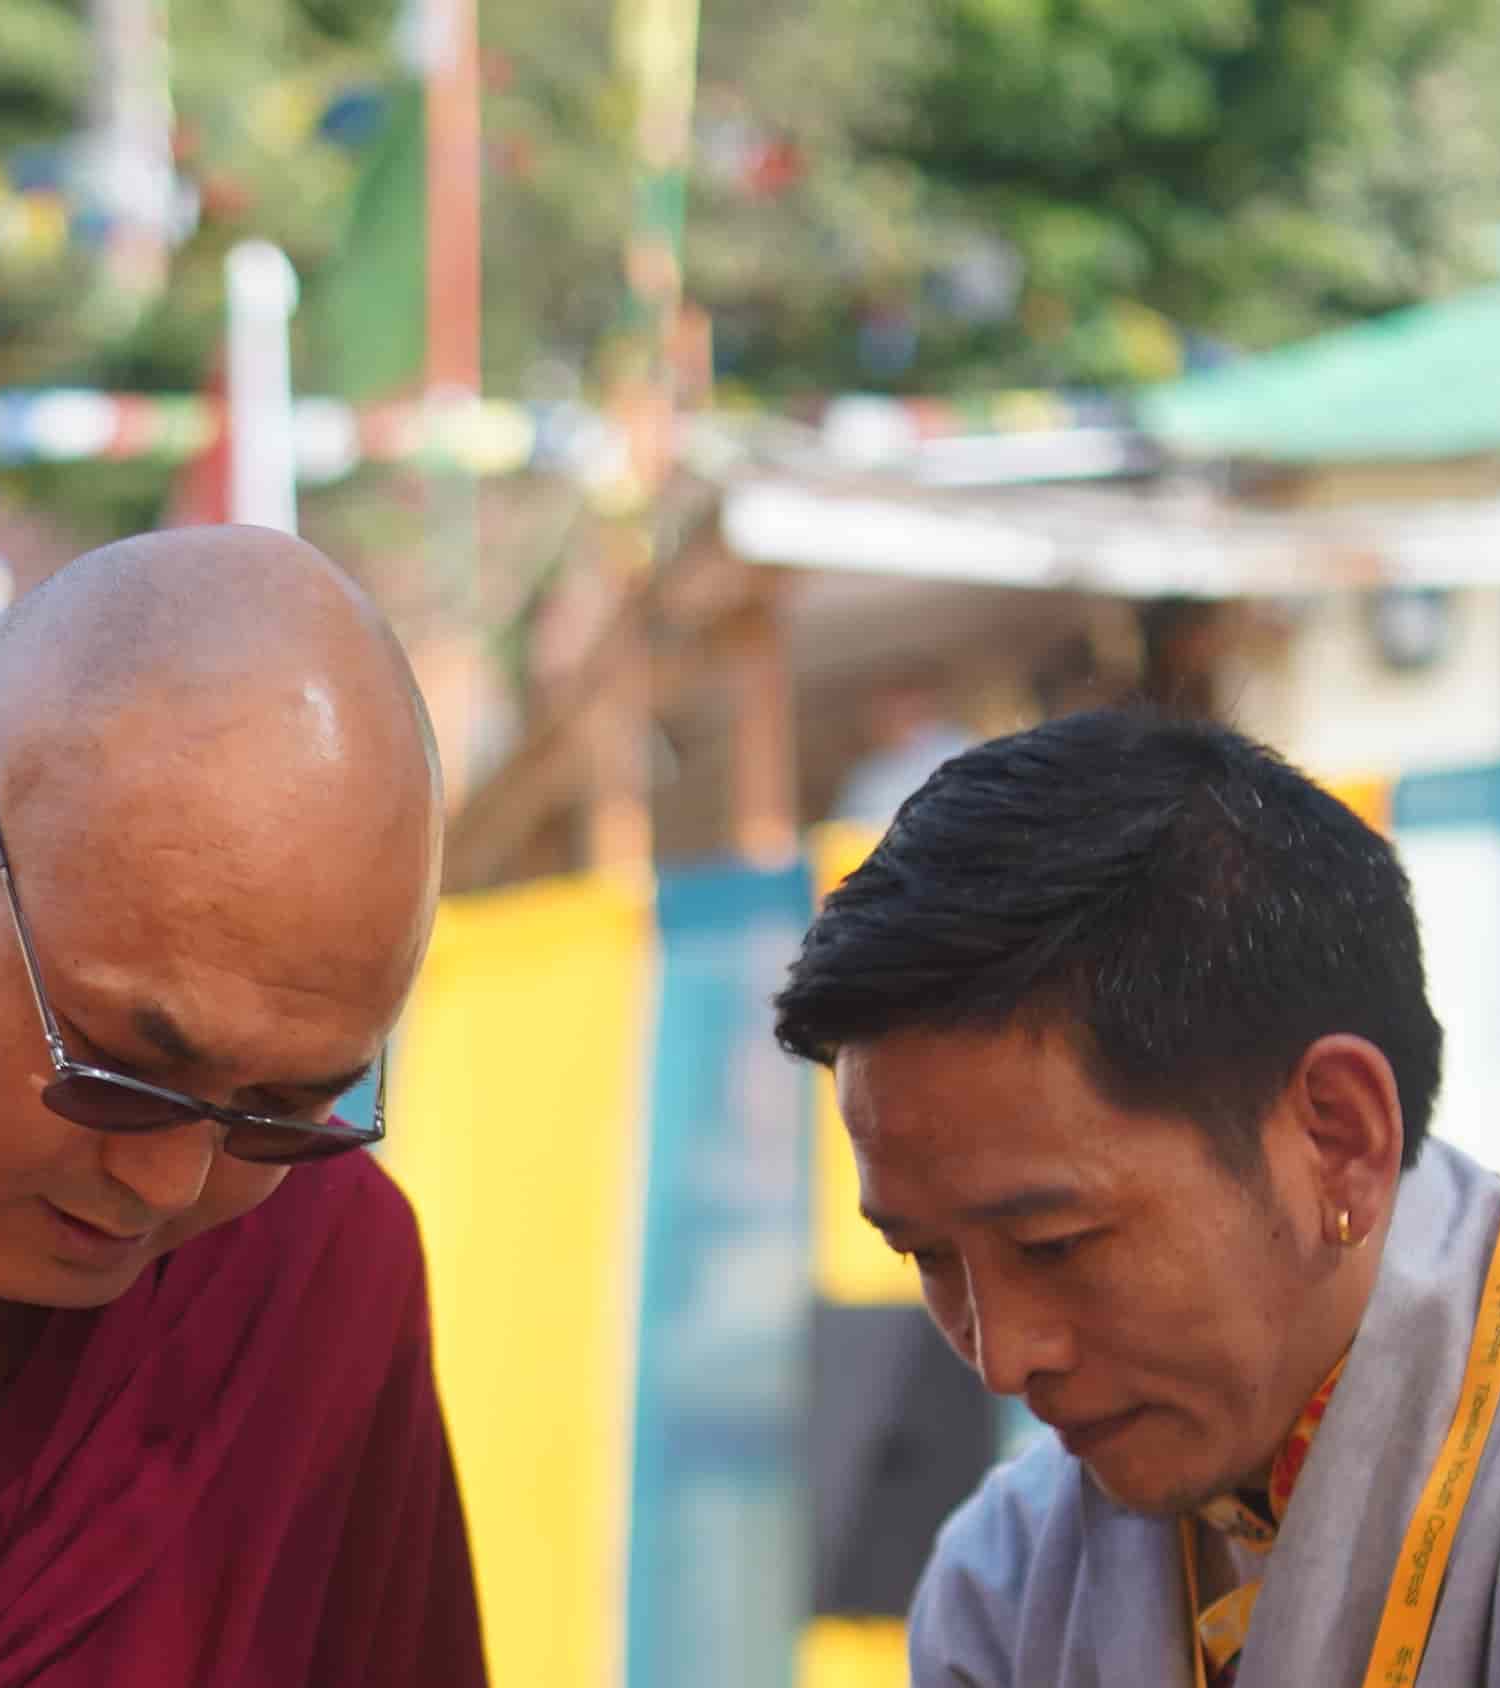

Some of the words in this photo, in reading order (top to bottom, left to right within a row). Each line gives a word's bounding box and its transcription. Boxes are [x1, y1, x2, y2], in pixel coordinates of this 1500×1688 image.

[1462, 1383, 1491, 1451] Tibetan
[1437, 1457, 1469, 1509] Youth
[1405, 1513, 1446, 1607] Congress
